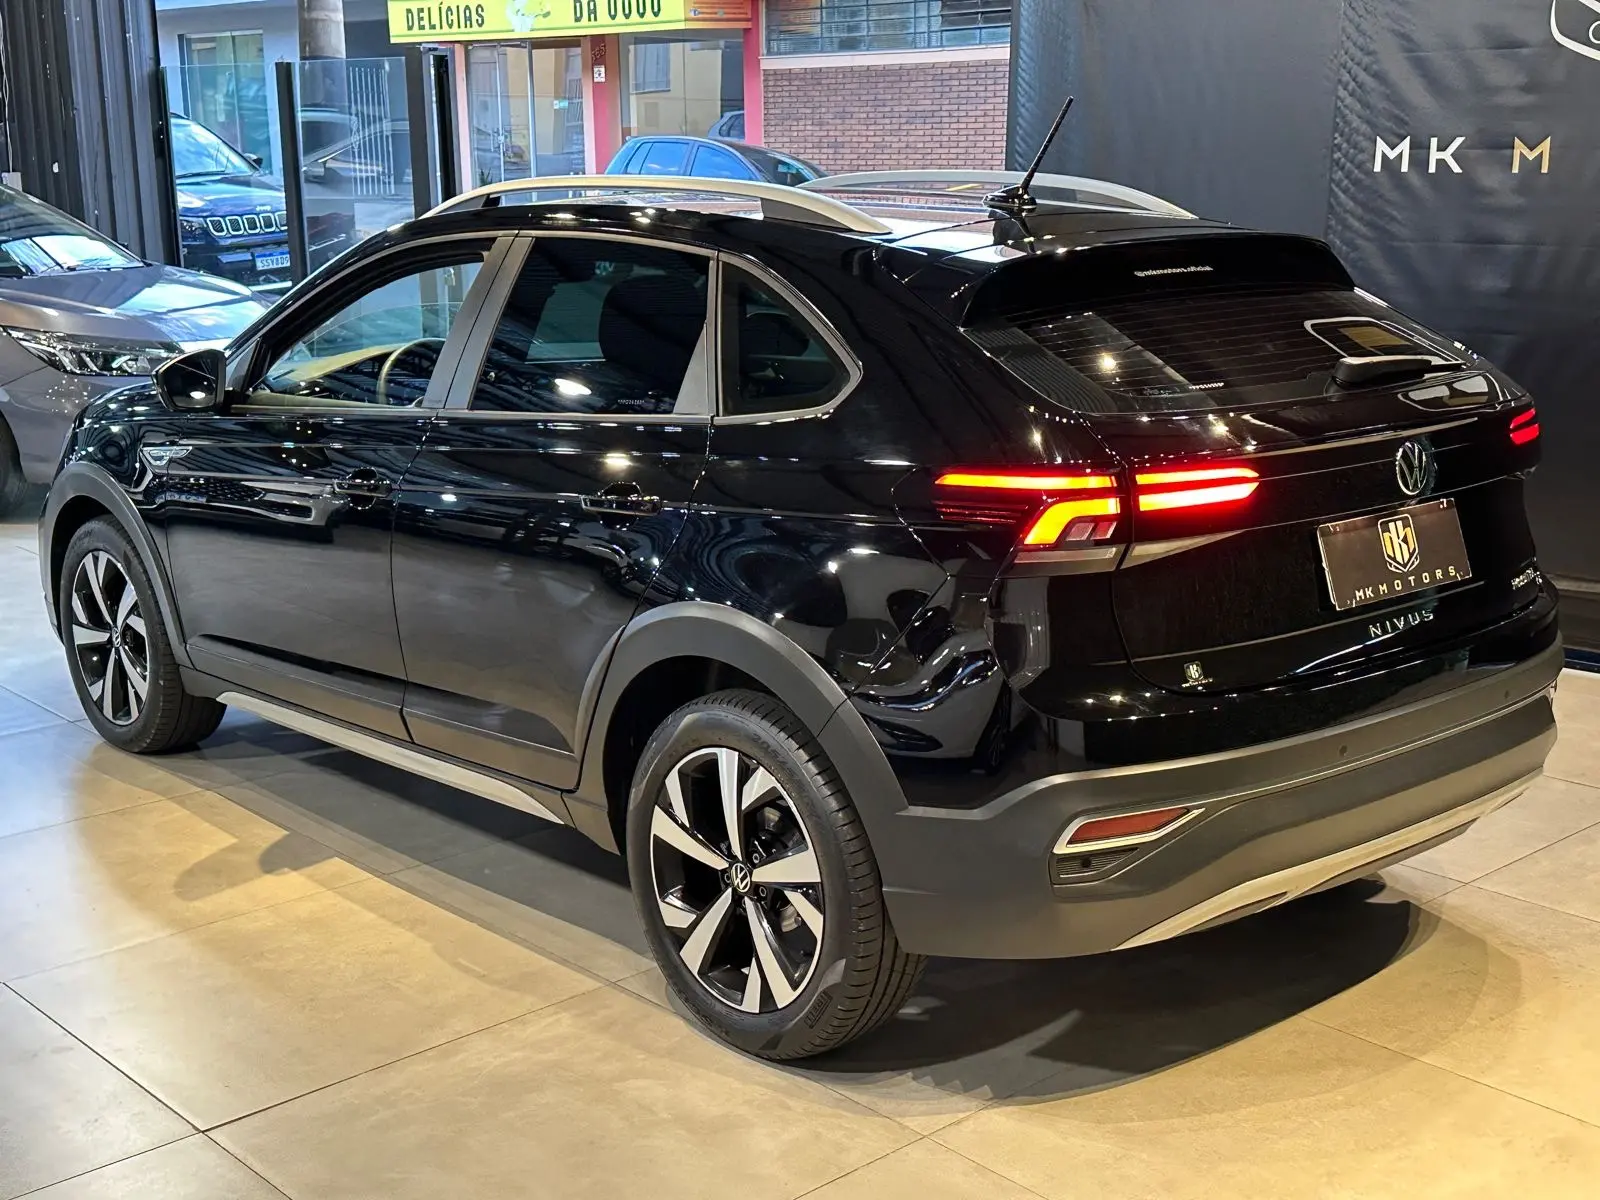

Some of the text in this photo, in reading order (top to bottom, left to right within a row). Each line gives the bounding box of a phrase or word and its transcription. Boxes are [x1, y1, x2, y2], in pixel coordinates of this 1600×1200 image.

[405, 1, 485, 31] DELÍCIAS
[573, 0, 598, 23] DA
[1373, 135, 1552, 174] MK M
[1355, 565, 1457, 602] MK MOTORS
[1368, 609, 1434, 638] NIVUS
